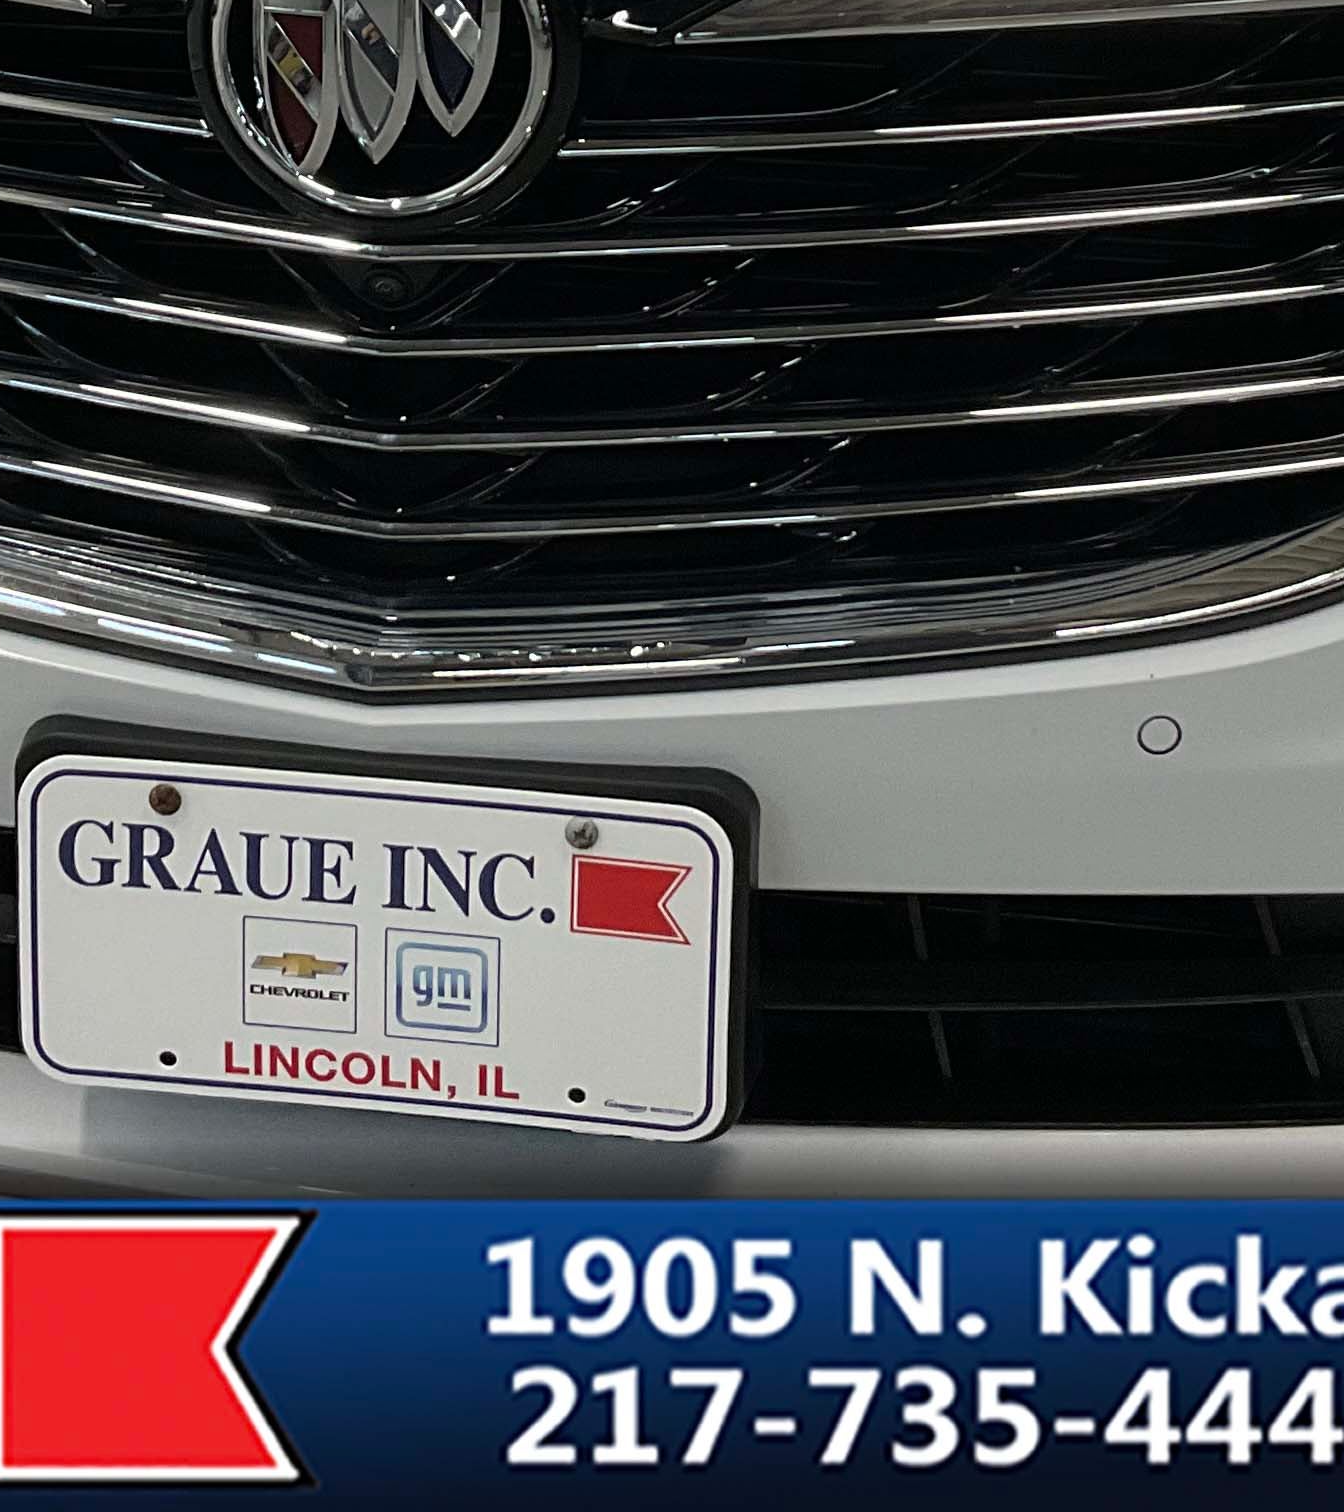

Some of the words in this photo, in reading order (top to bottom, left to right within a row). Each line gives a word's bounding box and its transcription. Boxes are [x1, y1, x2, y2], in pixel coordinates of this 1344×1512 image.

[58, 819, 357, 905] GRAUE
[381, 843, 556, 924] INC.
[249, 983, 350, 1002] CHEVROLET
[412, 964, 472, 1012] gm
[224, 1040, 456, 1100] LINCOLN,
[478, 1064, 520, 1100] IL
